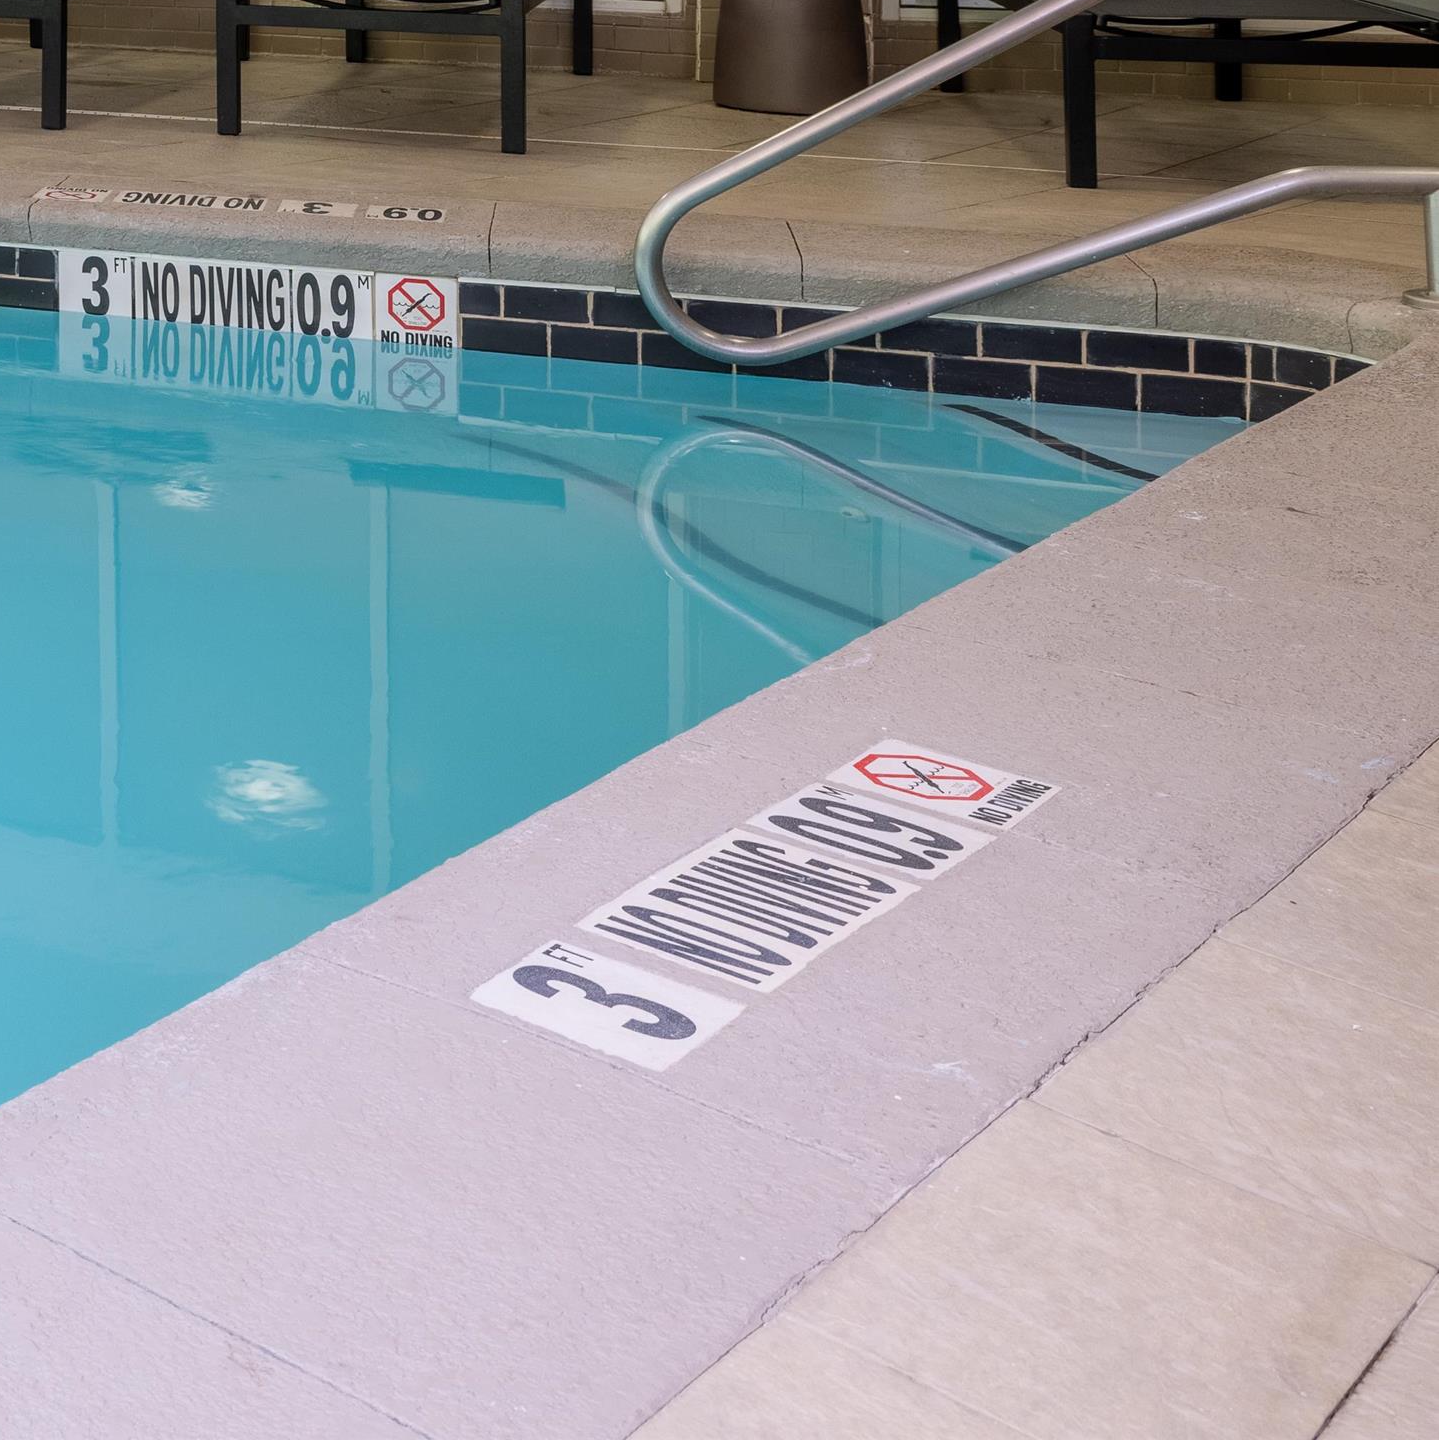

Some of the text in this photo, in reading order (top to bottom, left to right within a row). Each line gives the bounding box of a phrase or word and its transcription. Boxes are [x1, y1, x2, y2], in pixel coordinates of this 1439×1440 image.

[122, 190, 442, 222] 0.9 3 NO DIVING
[82, 256, 370, 339] 3 FT NO DIVING 0.9 M
[381, 330, 453, 349] NO DIVING
[969, 779, 1053, 827] NO DIVING
[512, 785, 964, 1041] 3 FT NO DIVING 0.9 M
